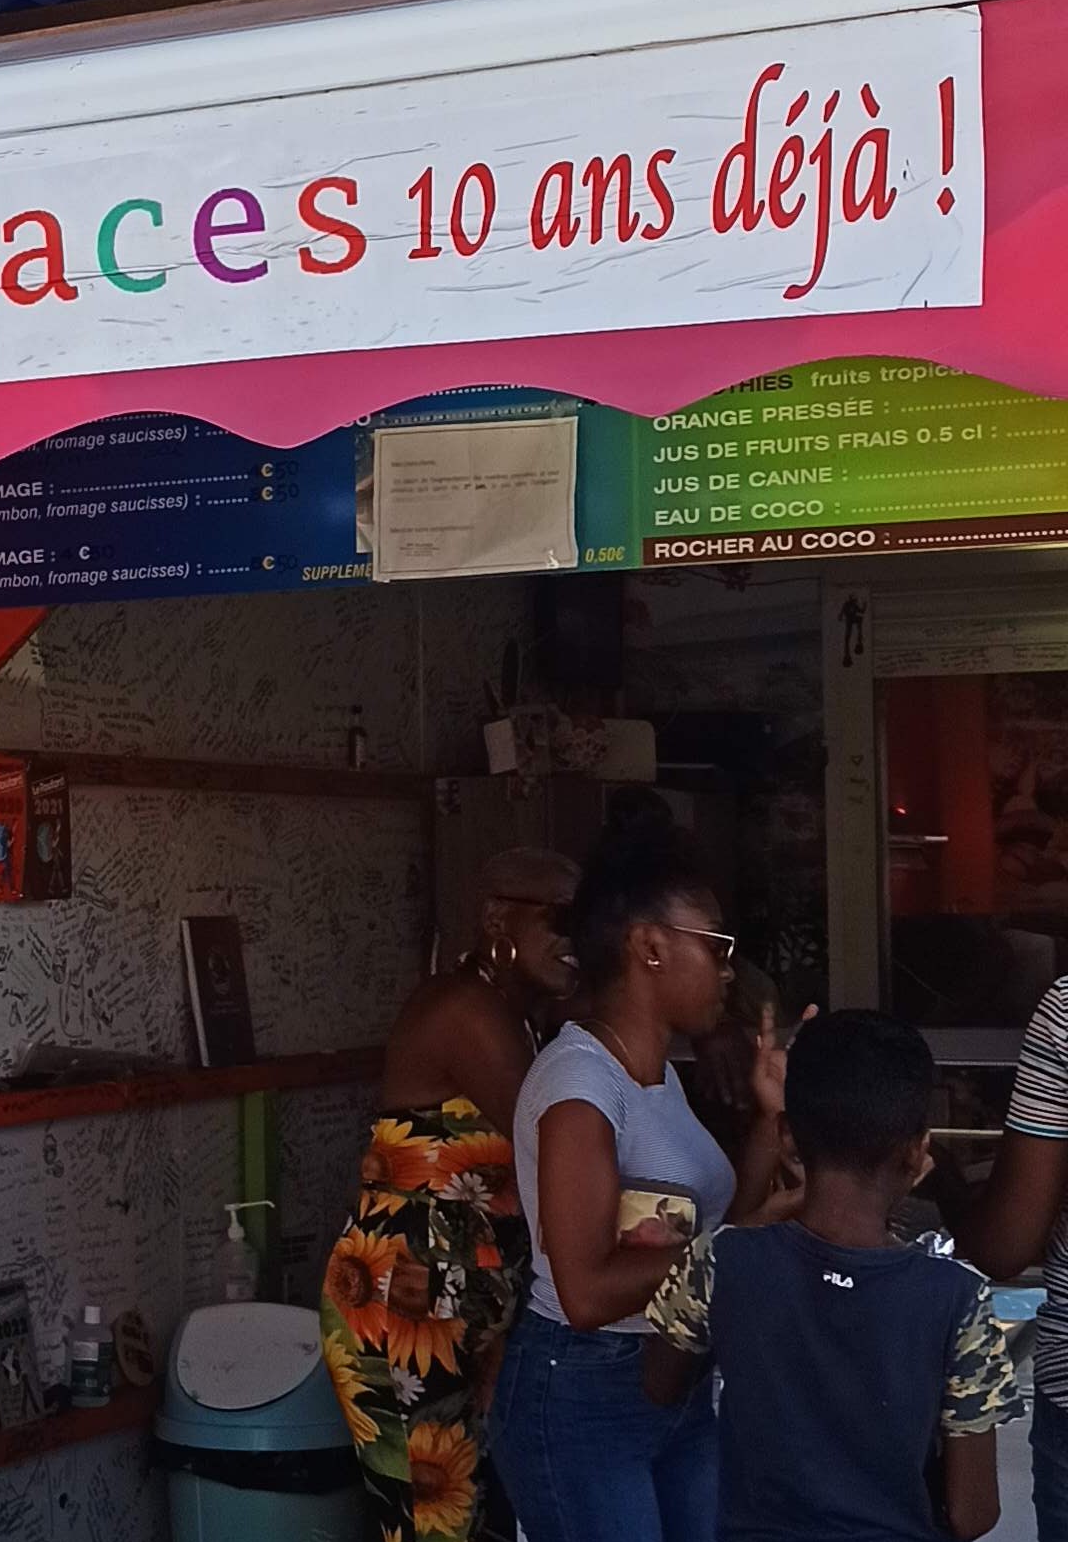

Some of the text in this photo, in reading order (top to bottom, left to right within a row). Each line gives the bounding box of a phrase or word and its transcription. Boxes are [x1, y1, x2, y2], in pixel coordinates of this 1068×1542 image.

[408, 162, 497, 260] 10
[531, 148, 677, 251] ans
[712, 62, 898, 300] déjà
[810, 369, 871, 387] fruits
[652, 409, 753, 431] ORANGE
[762, 397, 874, 424] PRESSÉE
[45, 432, 105, 452] fromage
[109, 424, 188, 445] saucisses)
[653, 444, 699, 463] JUS
[707, 442, 738, 459] DE
[746, 435, 830, 457] FRUITS
[838, 429, 909, 449] FRAIS
[916, 426, 953, 443] 0.5
[961, 424, 983, 440] cl
[653, 476, 700, 494] JUS
[708, 474, 740, 490] DE
[748, 467, 833, 487] CANNE
[46, 499, 106, 518] fromage
[111, 494, 189, 513] saucisses)
[655, 508, 700, 526] EAU
[710, 506, 741, 522] DE
[750, 500, 824, 520] COCO
[654, 538, 754, 559] ROCHER
[760, 535, 793, 552] AU
[801, 530, 876, 550] COCO
[48, 568, 107, 587] fromage
[112, 562, 190, 581] saucisses)
[34, 798, 64, 815] 2021
[823, 1270, 854, 1288] FILA
